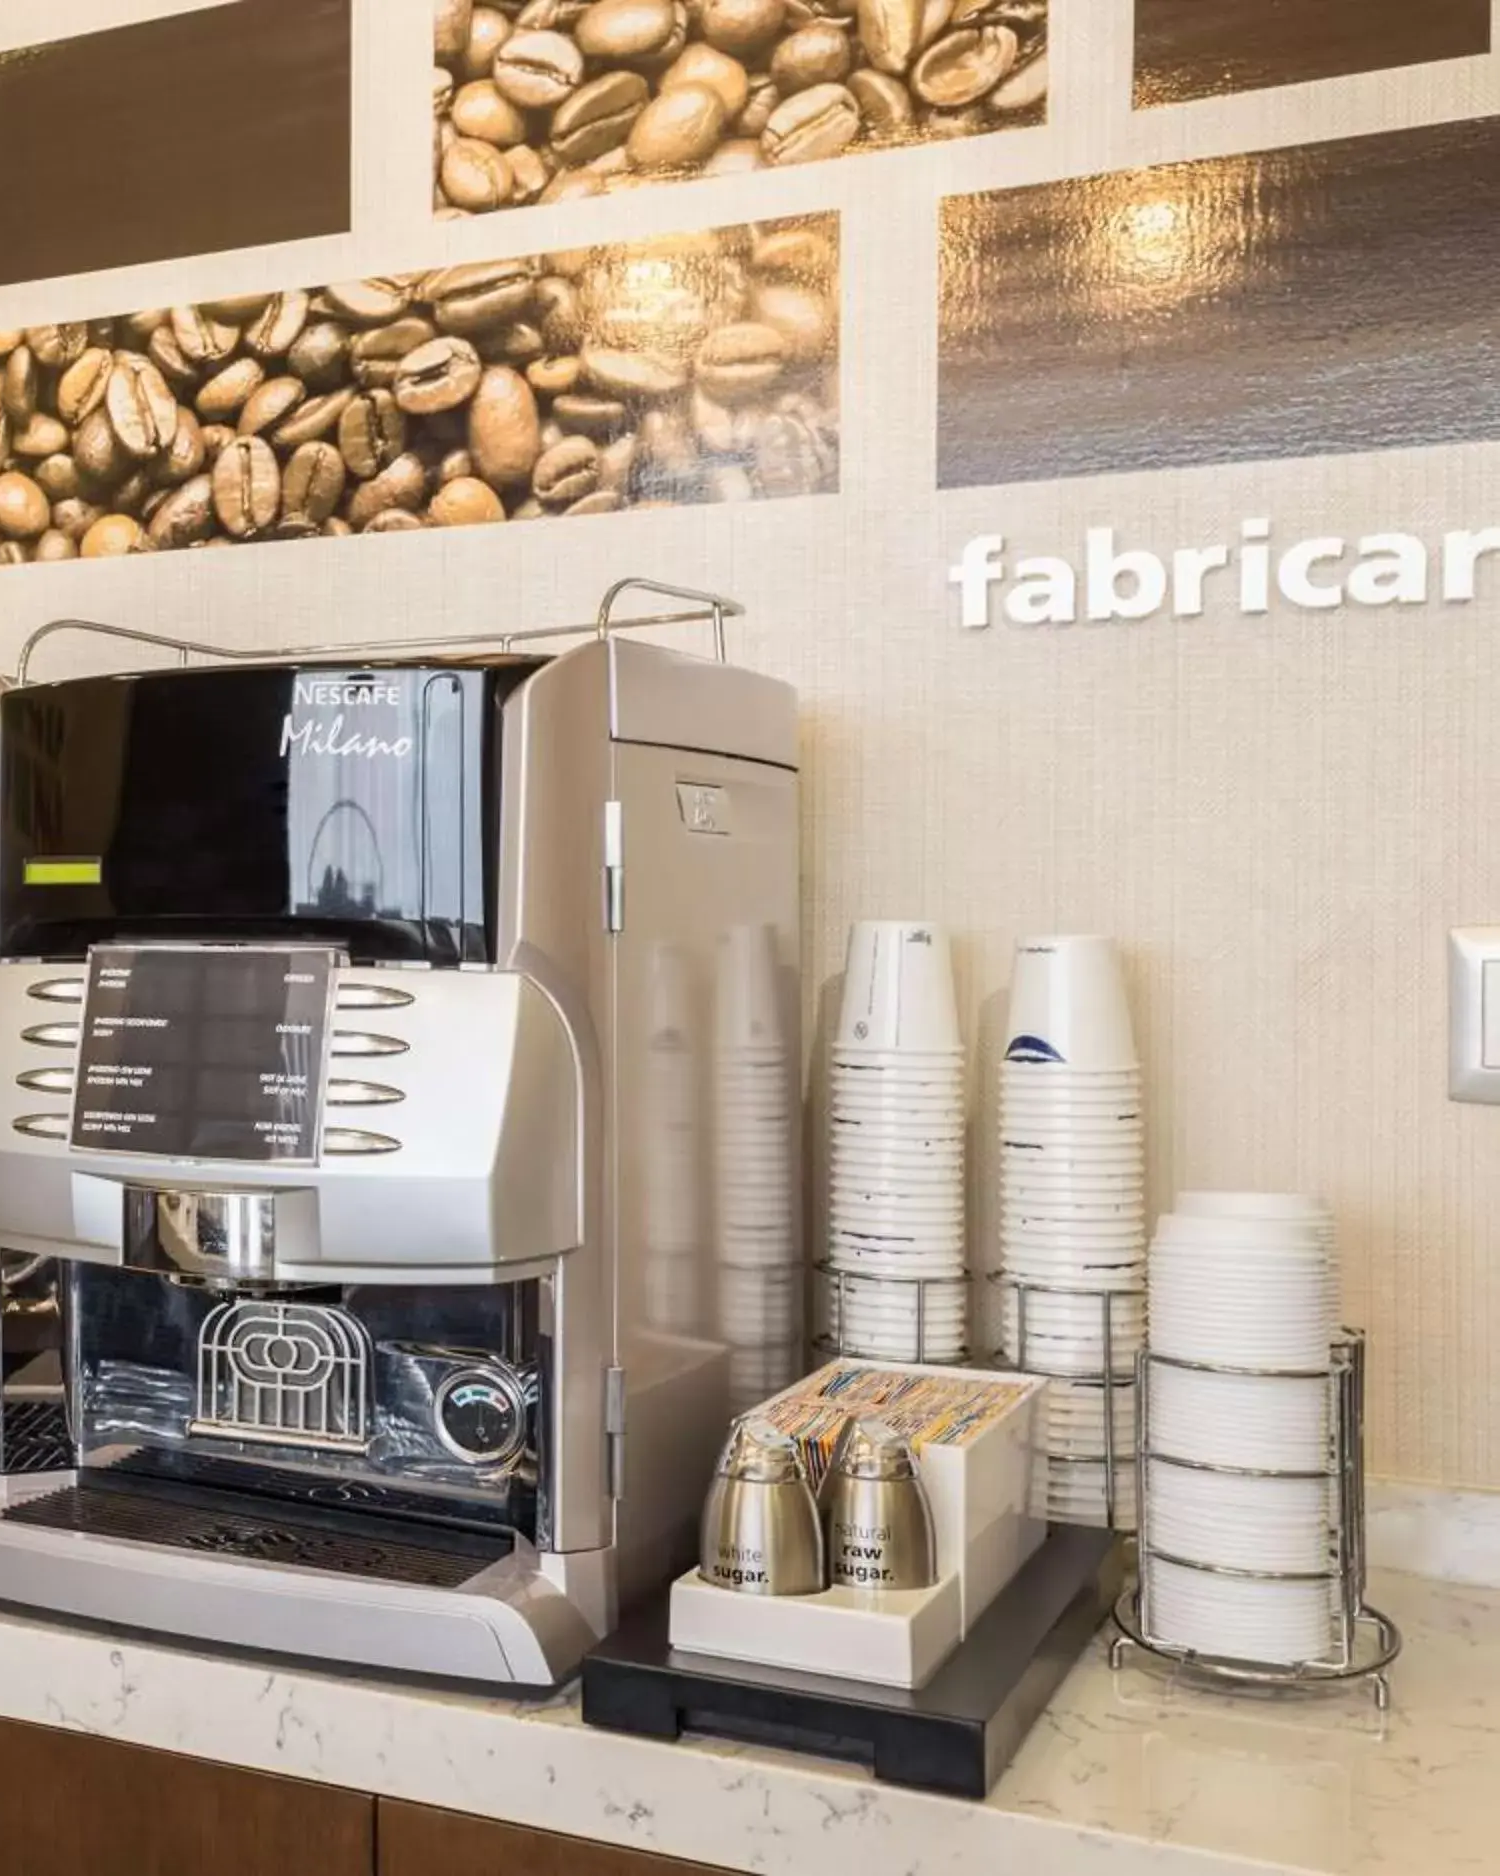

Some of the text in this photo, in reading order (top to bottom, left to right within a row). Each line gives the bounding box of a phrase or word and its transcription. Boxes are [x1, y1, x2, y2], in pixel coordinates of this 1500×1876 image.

[280, 714, 412, 758] Milano
[717, 1544, 761, 1563] white
[841, 1545, 882, 1560] raw
[713, 1565, 769, 1584] sugar.
[837, 1563, 895, 1582] sugar.
